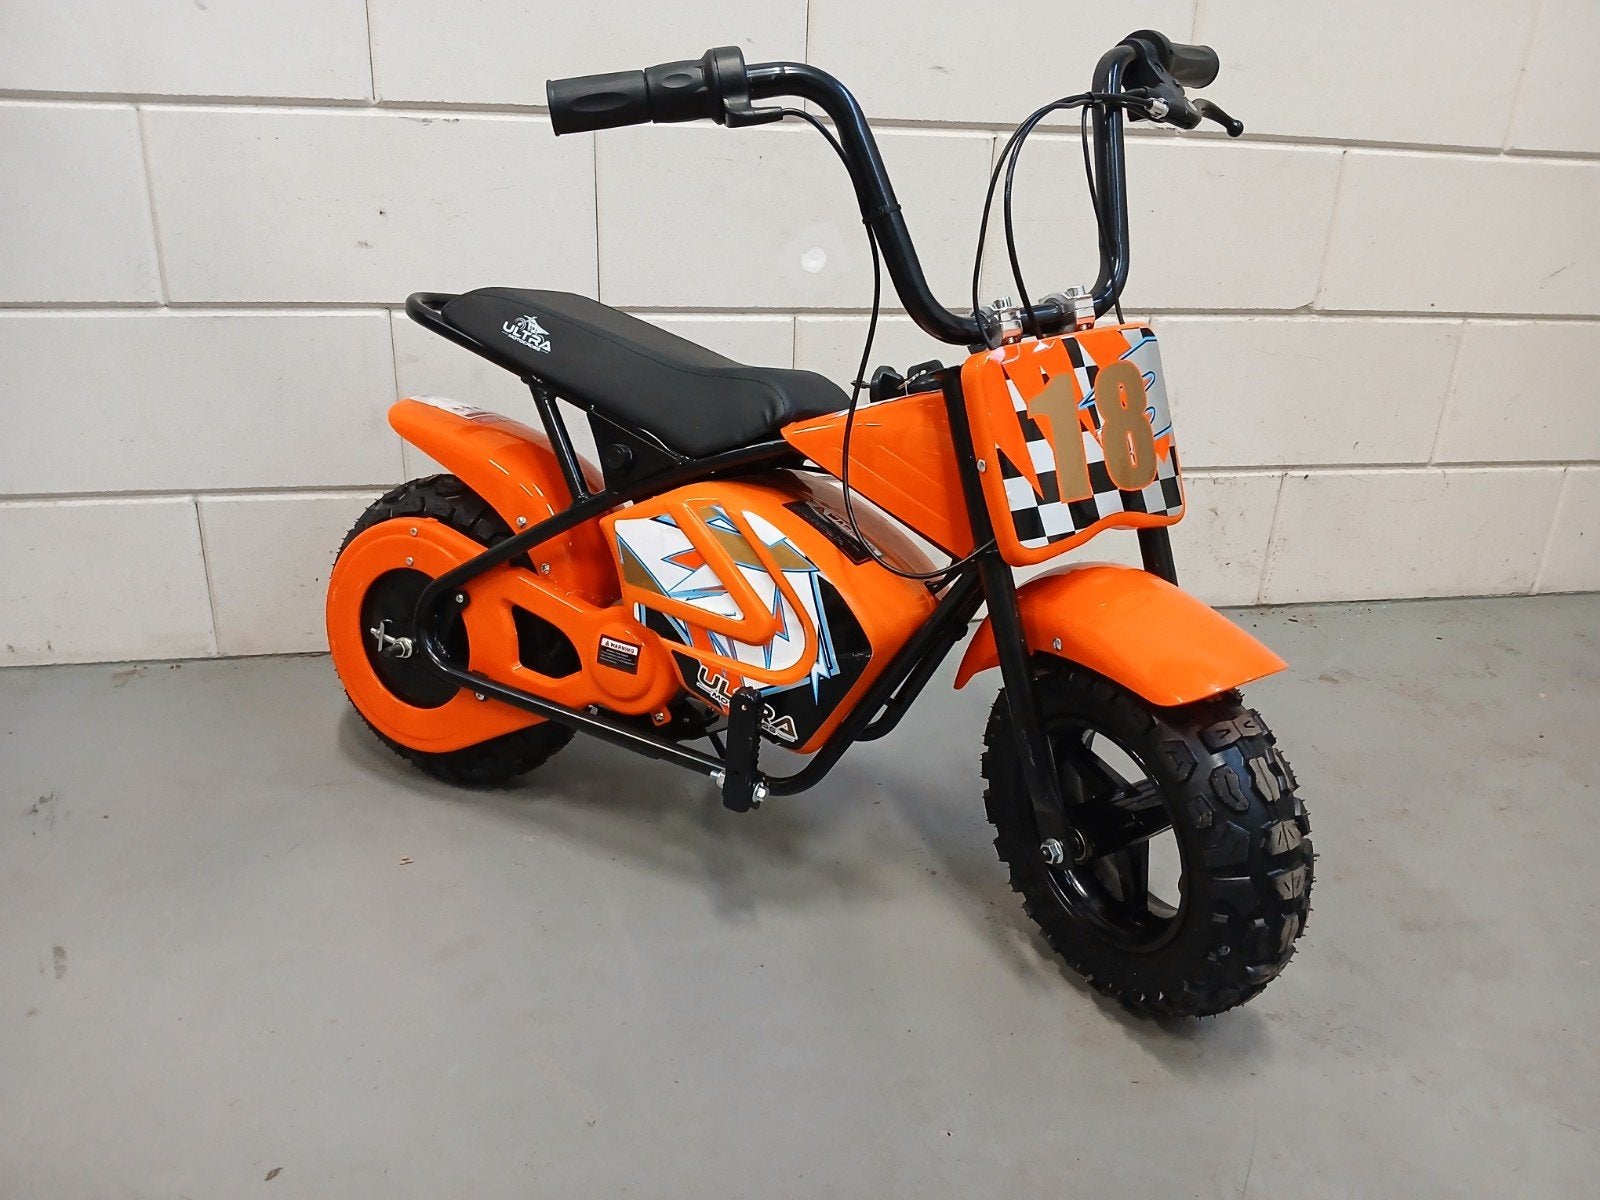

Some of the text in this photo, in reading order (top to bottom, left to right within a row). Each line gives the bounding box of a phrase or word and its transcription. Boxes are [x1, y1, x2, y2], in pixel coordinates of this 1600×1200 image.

[502, 321, 551, 352] ULTRA
[1028, 359, 1157, 503] 18
[697, 665, 799, 741] ULRA
